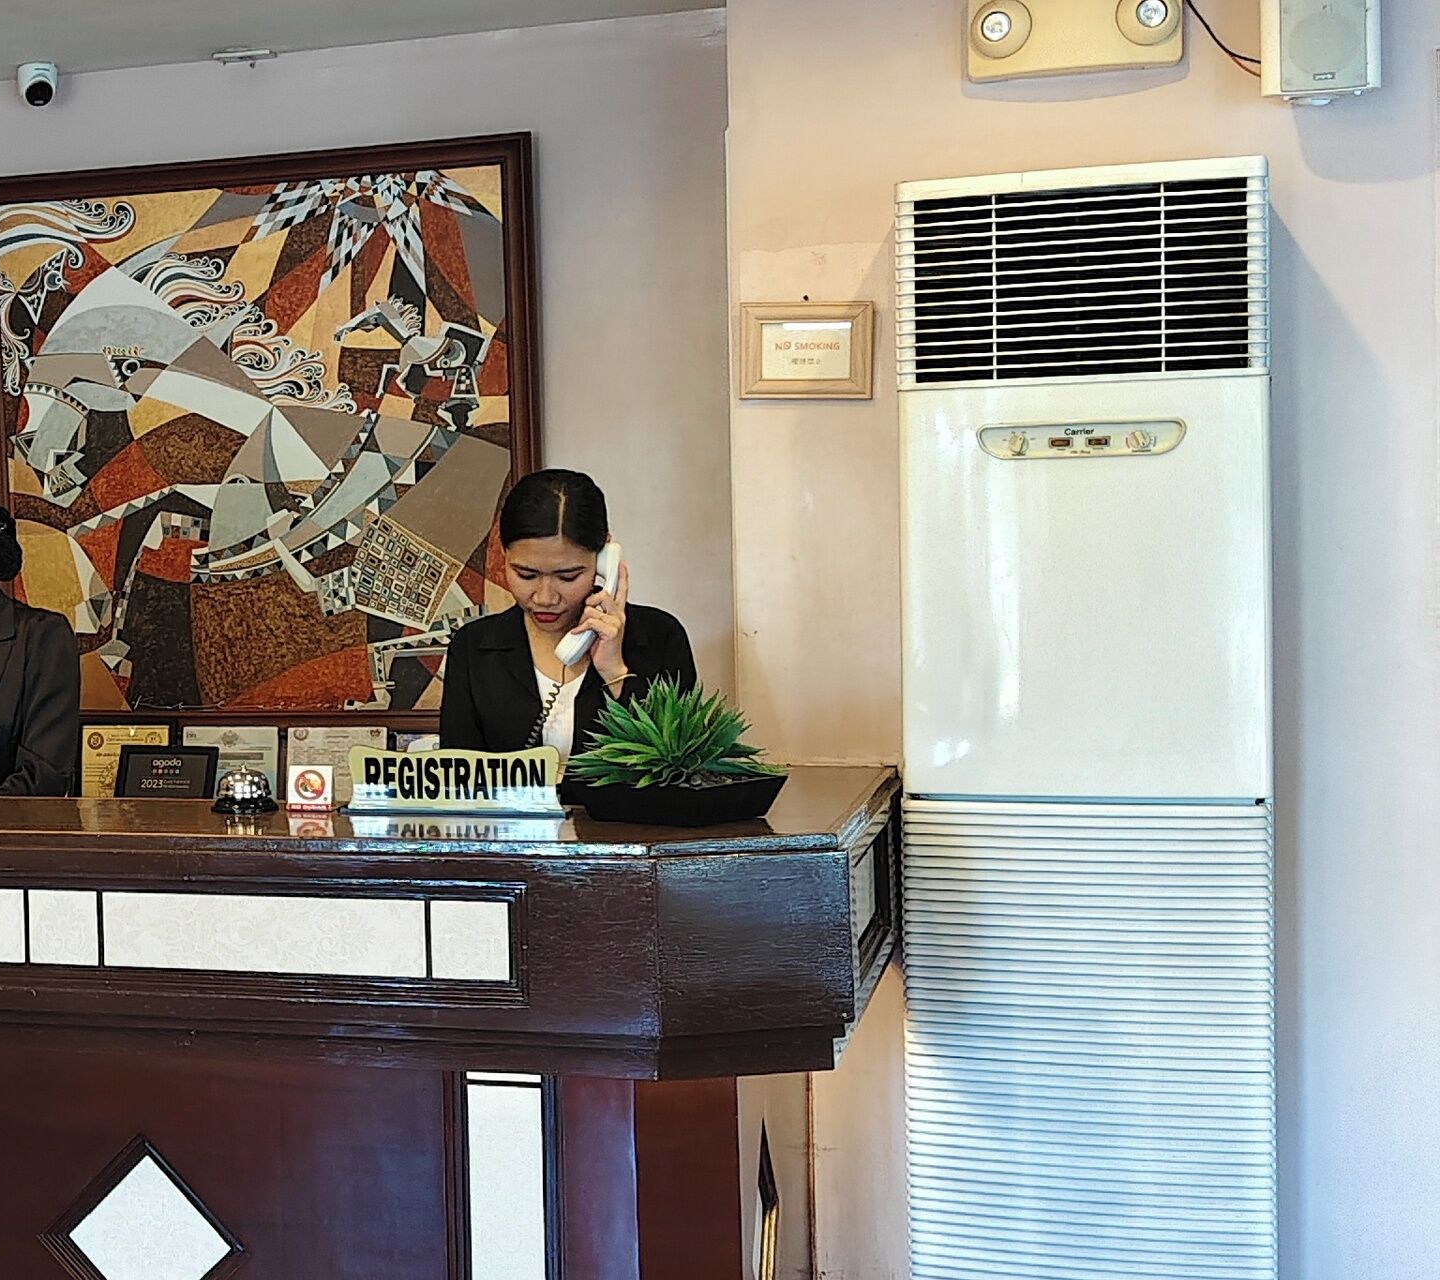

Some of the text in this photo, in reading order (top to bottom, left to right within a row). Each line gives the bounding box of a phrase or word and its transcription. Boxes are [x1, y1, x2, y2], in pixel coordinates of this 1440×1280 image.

[775, 341, 840, 351] NO SMOKING
[1064, 428, 1095, 436] Carrier
[152, 758, 182, 768] agoda
[364, 757, 546, 800] REGISTRATION
[140, 779, 164, 789] 2023
